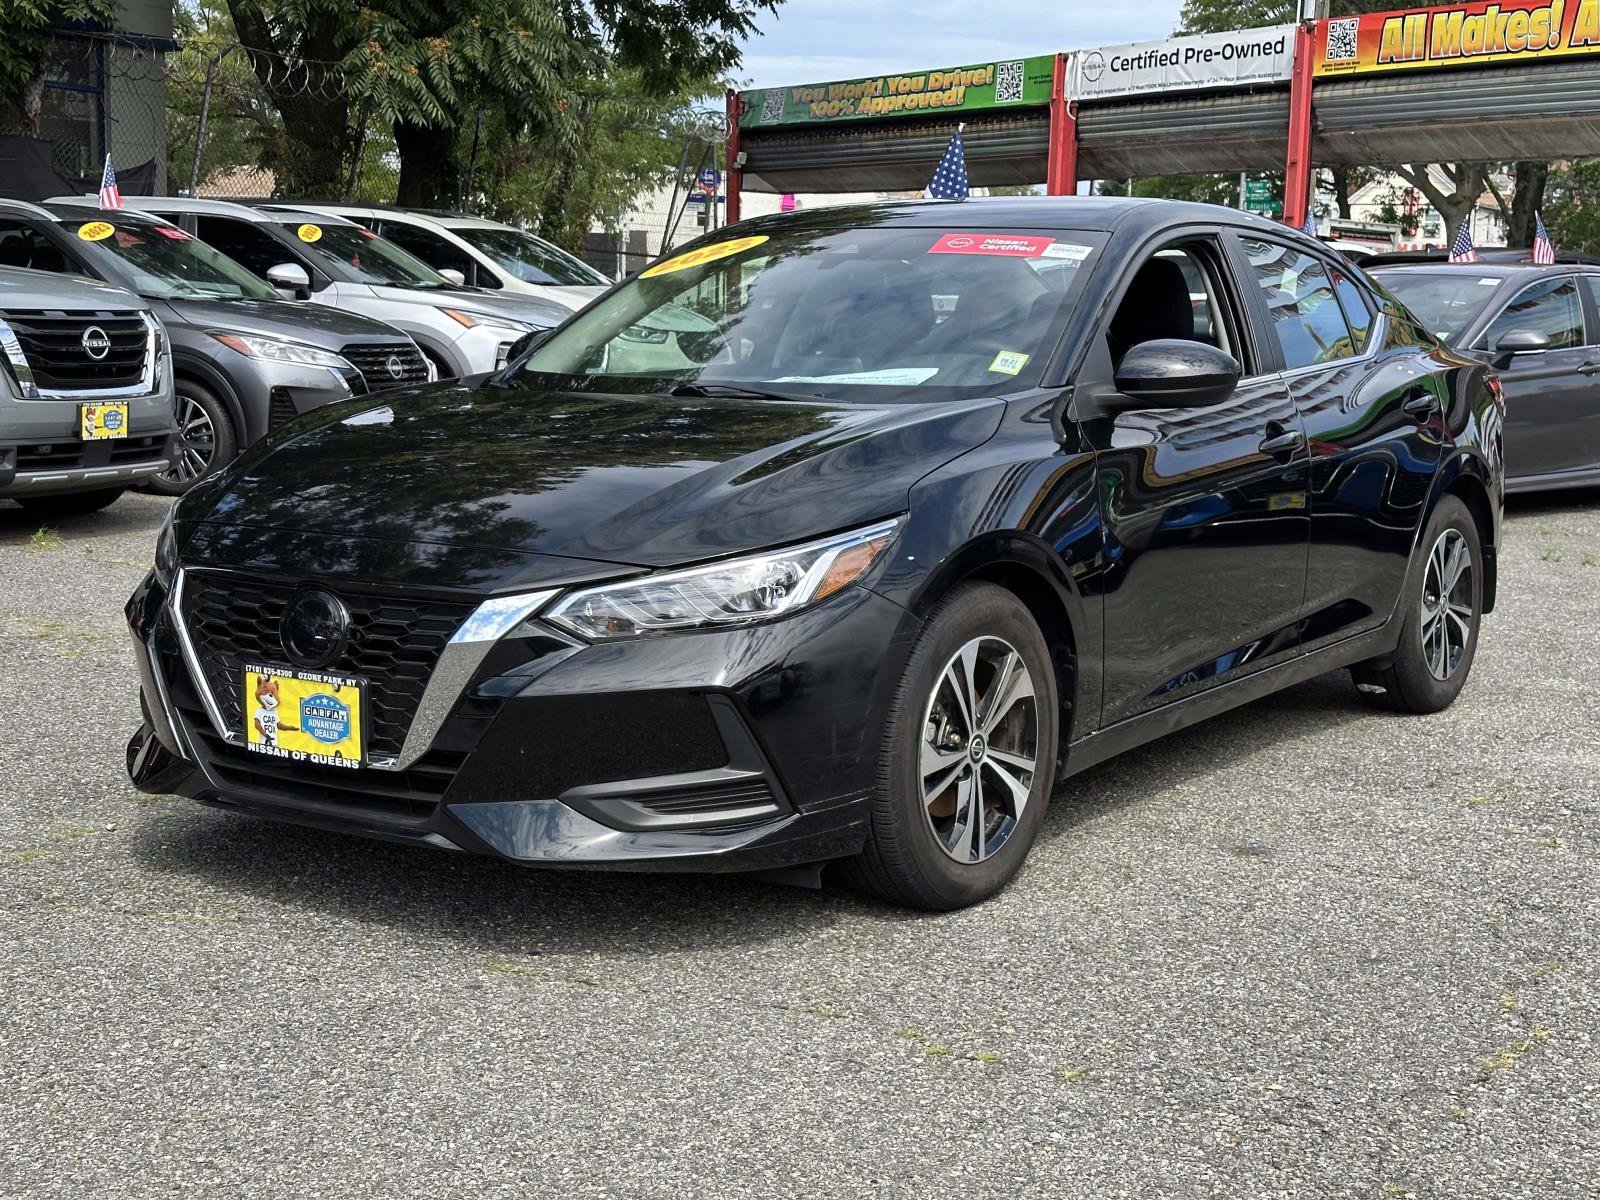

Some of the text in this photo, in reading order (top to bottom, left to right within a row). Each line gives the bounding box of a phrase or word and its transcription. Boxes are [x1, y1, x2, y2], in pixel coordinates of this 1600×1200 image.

[1379, 13, 1428, 63] All
[1430, 0, 1563, 58] Makes!
[1110, 35, 1285, 72] Certified Pre-Owned
[791, 64, 995, 104] You Work! You Drive!
[809, 86, 966, 117] 100% Approved!
[979, 244, 1037, 252] Certified
[984, 238, 1028, 246] Nissan
[298, 672, 321, 683] OZONE
[346, 678, 357, 687] NY
[263, 715, 276, 723] CAR
[304, 705, 347, 722] CARFAX
[264, 724, 276, 734] FOX
[308, 718, 344, 732] ADVANTAGE
[314, 728, 338, 740] DEALER
[247, 741, 360, 769] NISSAN OF QUEENS
